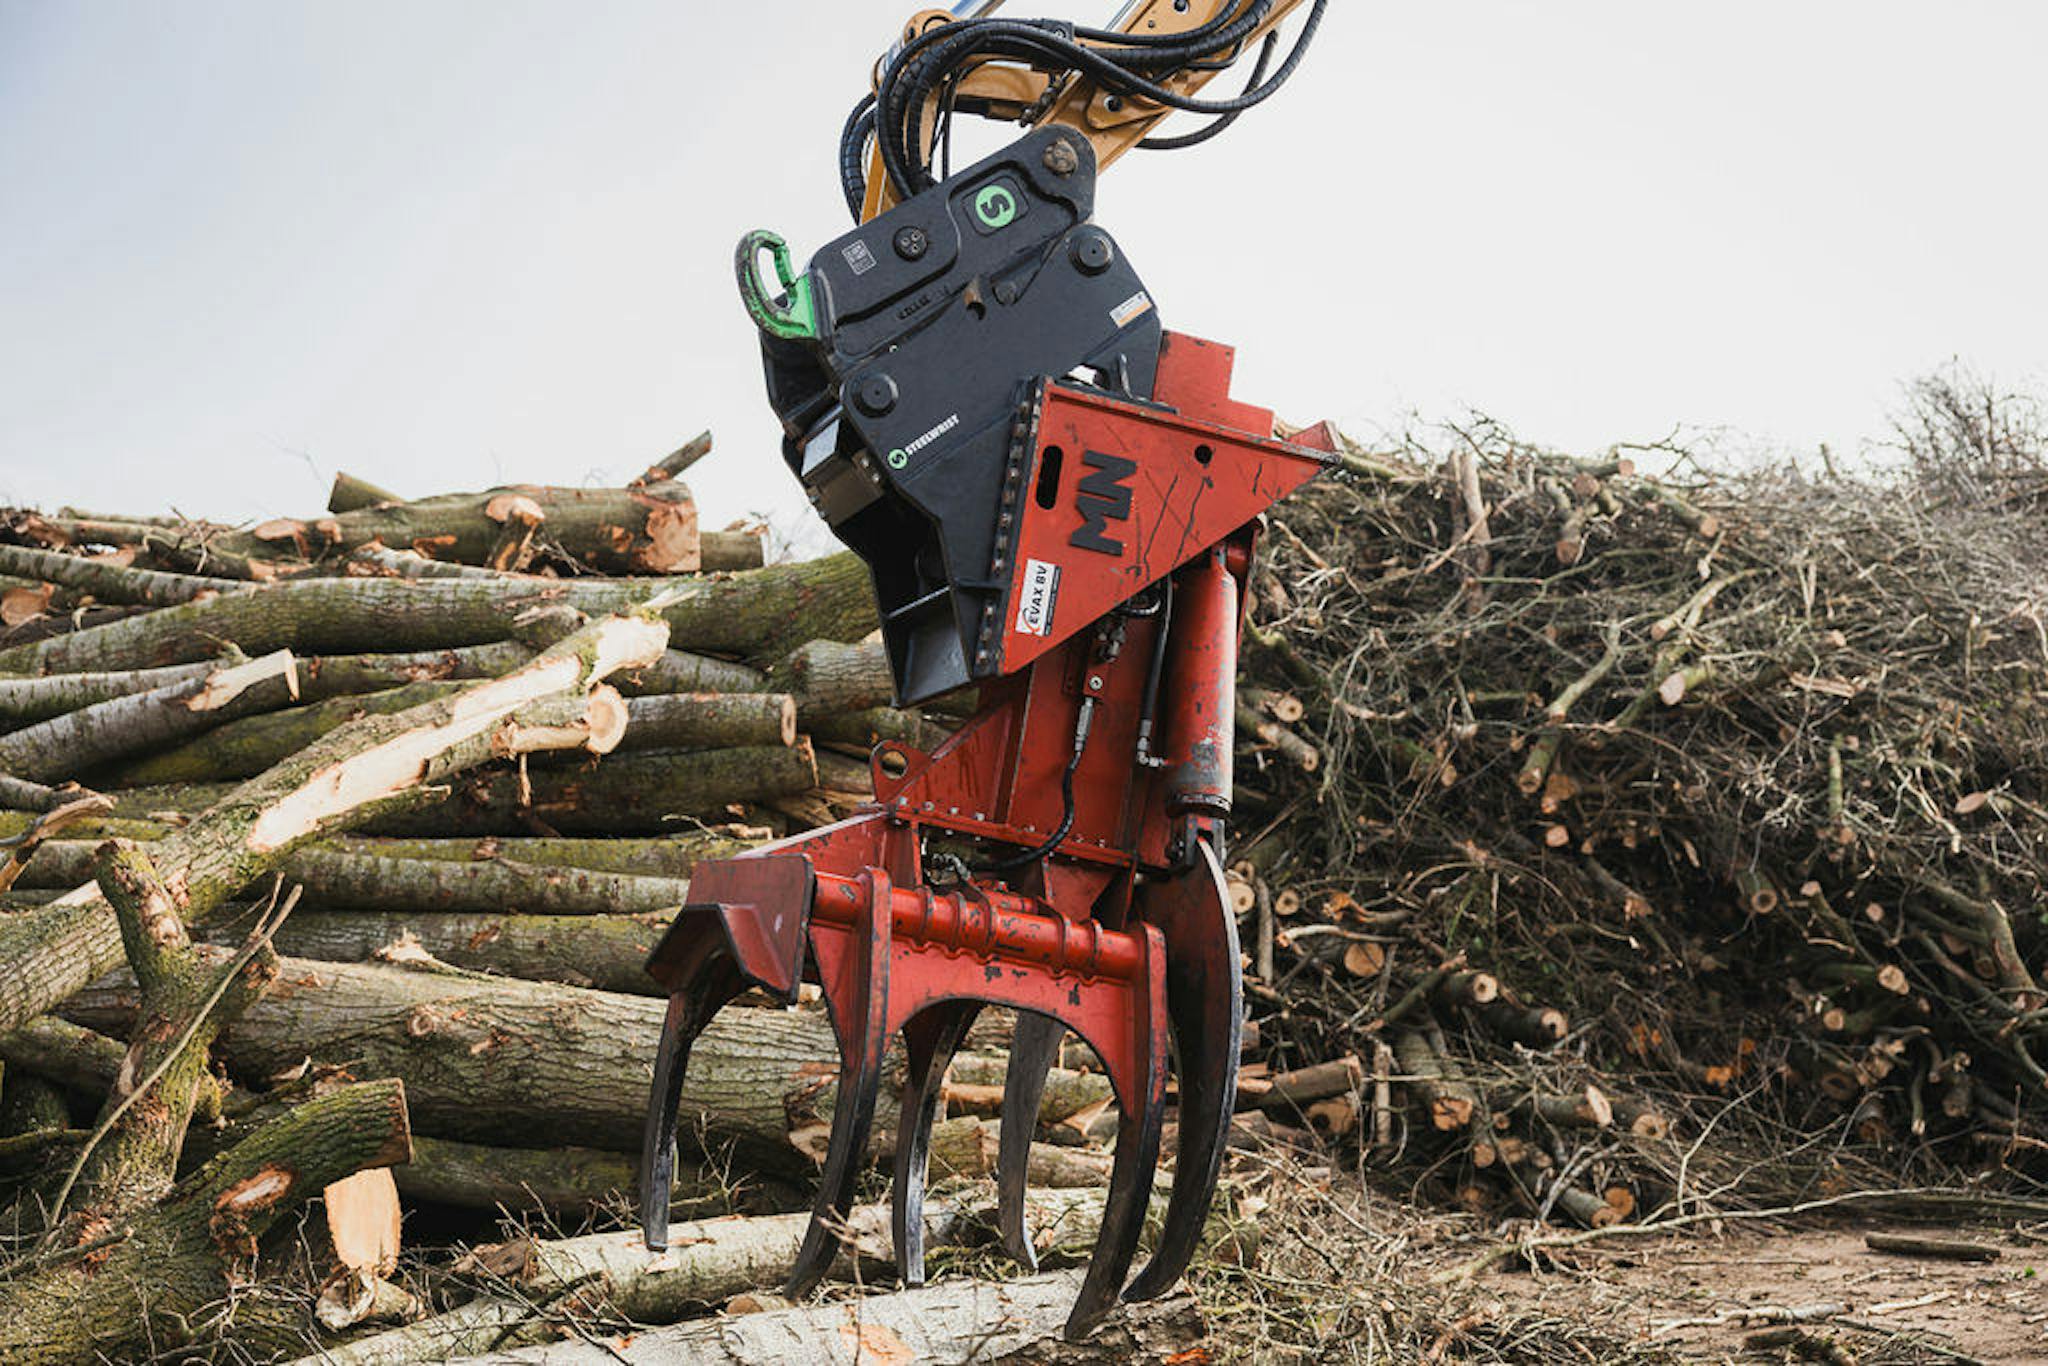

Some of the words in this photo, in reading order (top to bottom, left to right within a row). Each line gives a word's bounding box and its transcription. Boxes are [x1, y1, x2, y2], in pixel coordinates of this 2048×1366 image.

[905, 413, 960, 456] STEELWRIST
[1068, 450, 1137, 557] MN
[1035, 565, 1049, 585] BV
[1027, 587, 1045, 625] EVAX
